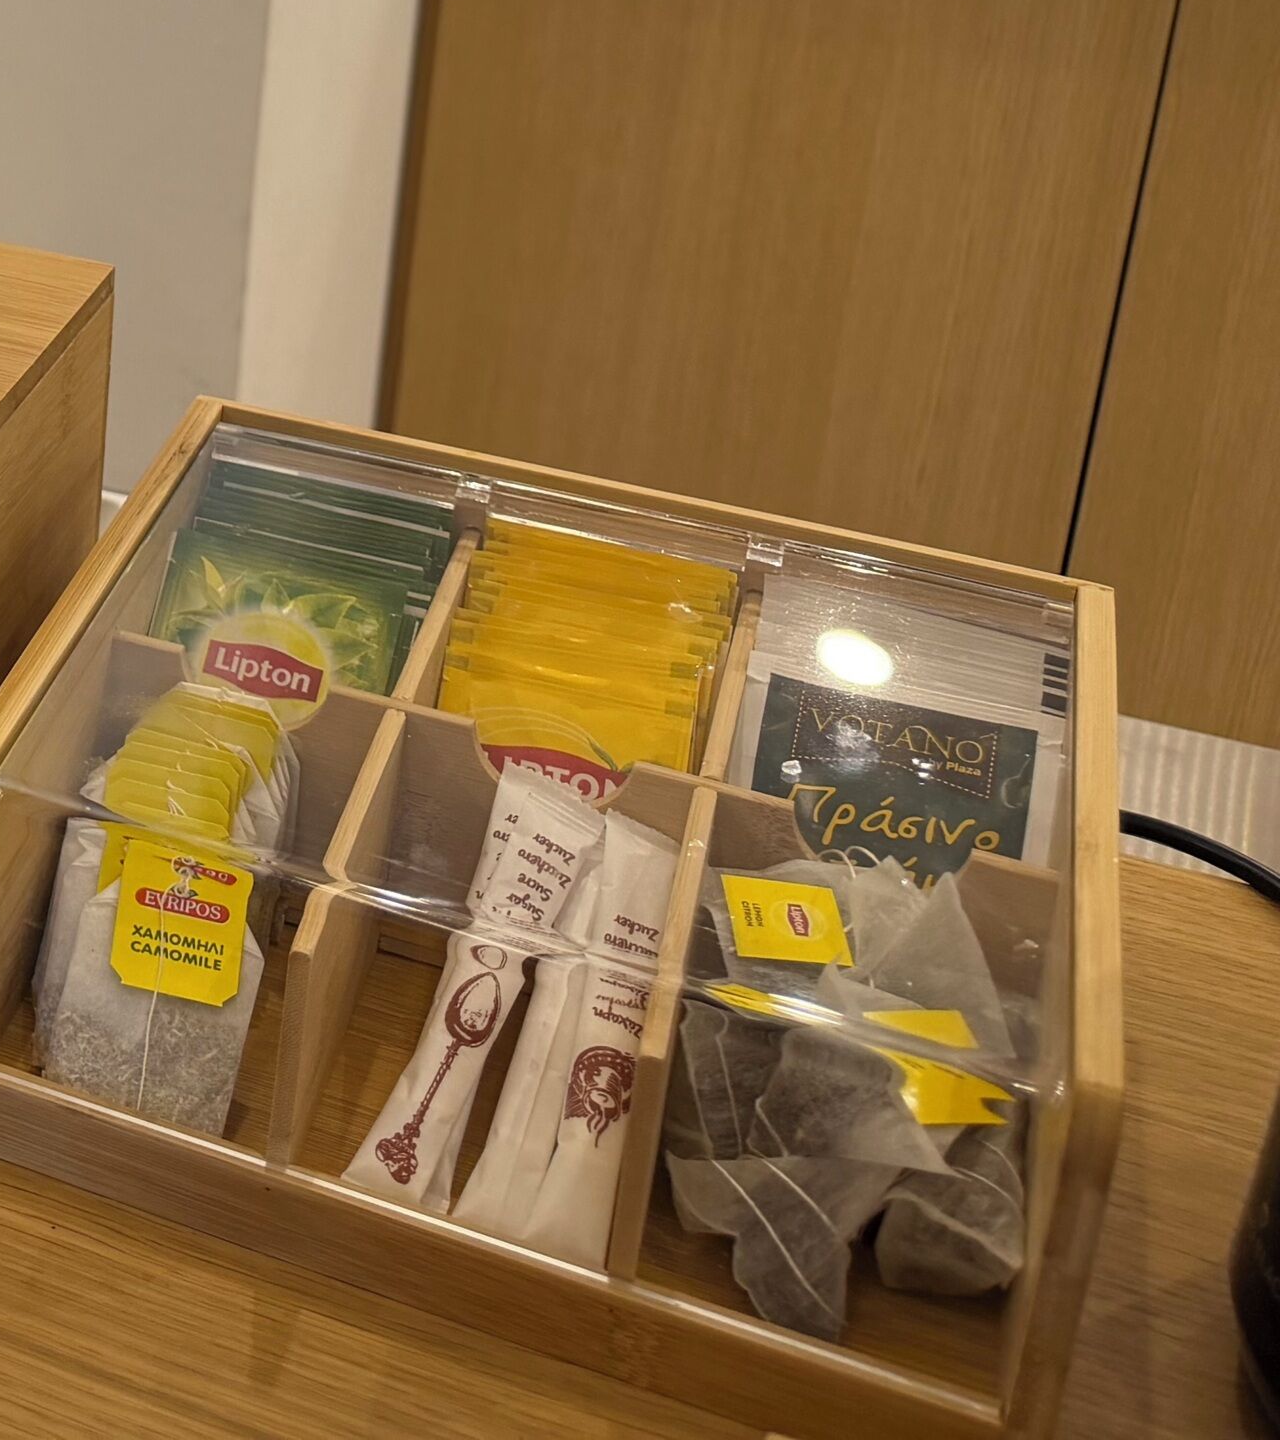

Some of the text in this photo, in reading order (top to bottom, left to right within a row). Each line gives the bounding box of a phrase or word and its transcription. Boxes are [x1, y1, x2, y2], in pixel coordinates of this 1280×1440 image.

[213, 645, 314, 694] Lipton
[946, 761, 982, 777] Plaza
[788, 783, 1001, 850] Πράσινο
[532, 832, 576, 866] Zucker
[518, 873, 553, 902] Sucre
[144, 890, 222, 921] EVRIPOS
[506, 893, 544, 921] Sugar
[752, 902, 764, 927] LEMON
[790, 906, 805, 934] Lipton
[614, 914, 660, 941] Zucker
[130, 941, 223, 971] CAMOMILE
